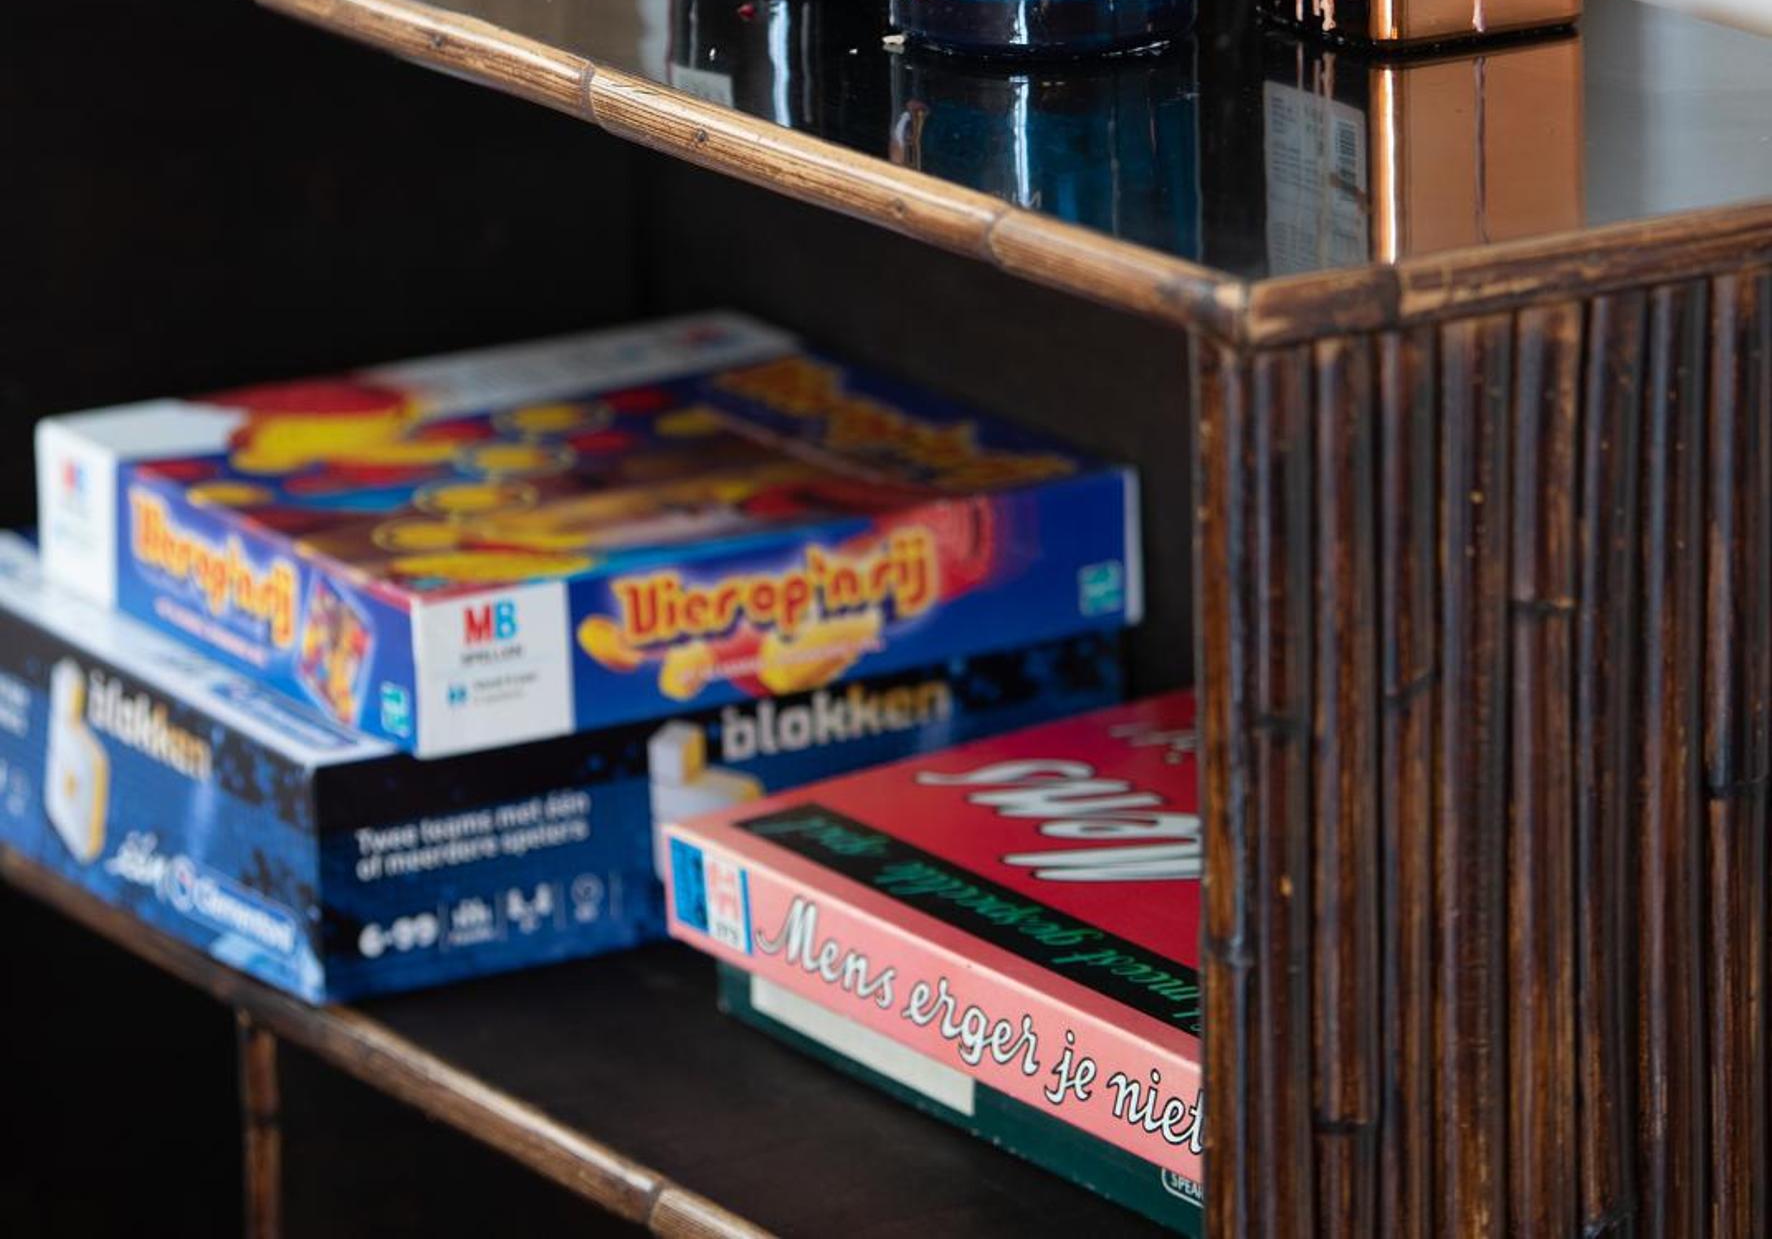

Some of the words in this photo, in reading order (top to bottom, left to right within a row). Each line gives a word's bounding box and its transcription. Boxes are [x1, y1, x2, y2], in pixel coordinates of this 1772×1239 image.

[463, 599, 518, 643] MB
[612, 566, 742, 644] Vier
[721, 681, 953, 762] blokken
[755, 894, 897, 1010] Mens
[901, 975, 1041, 1076] erger
[1043, 1028, 1098, 1104] je
